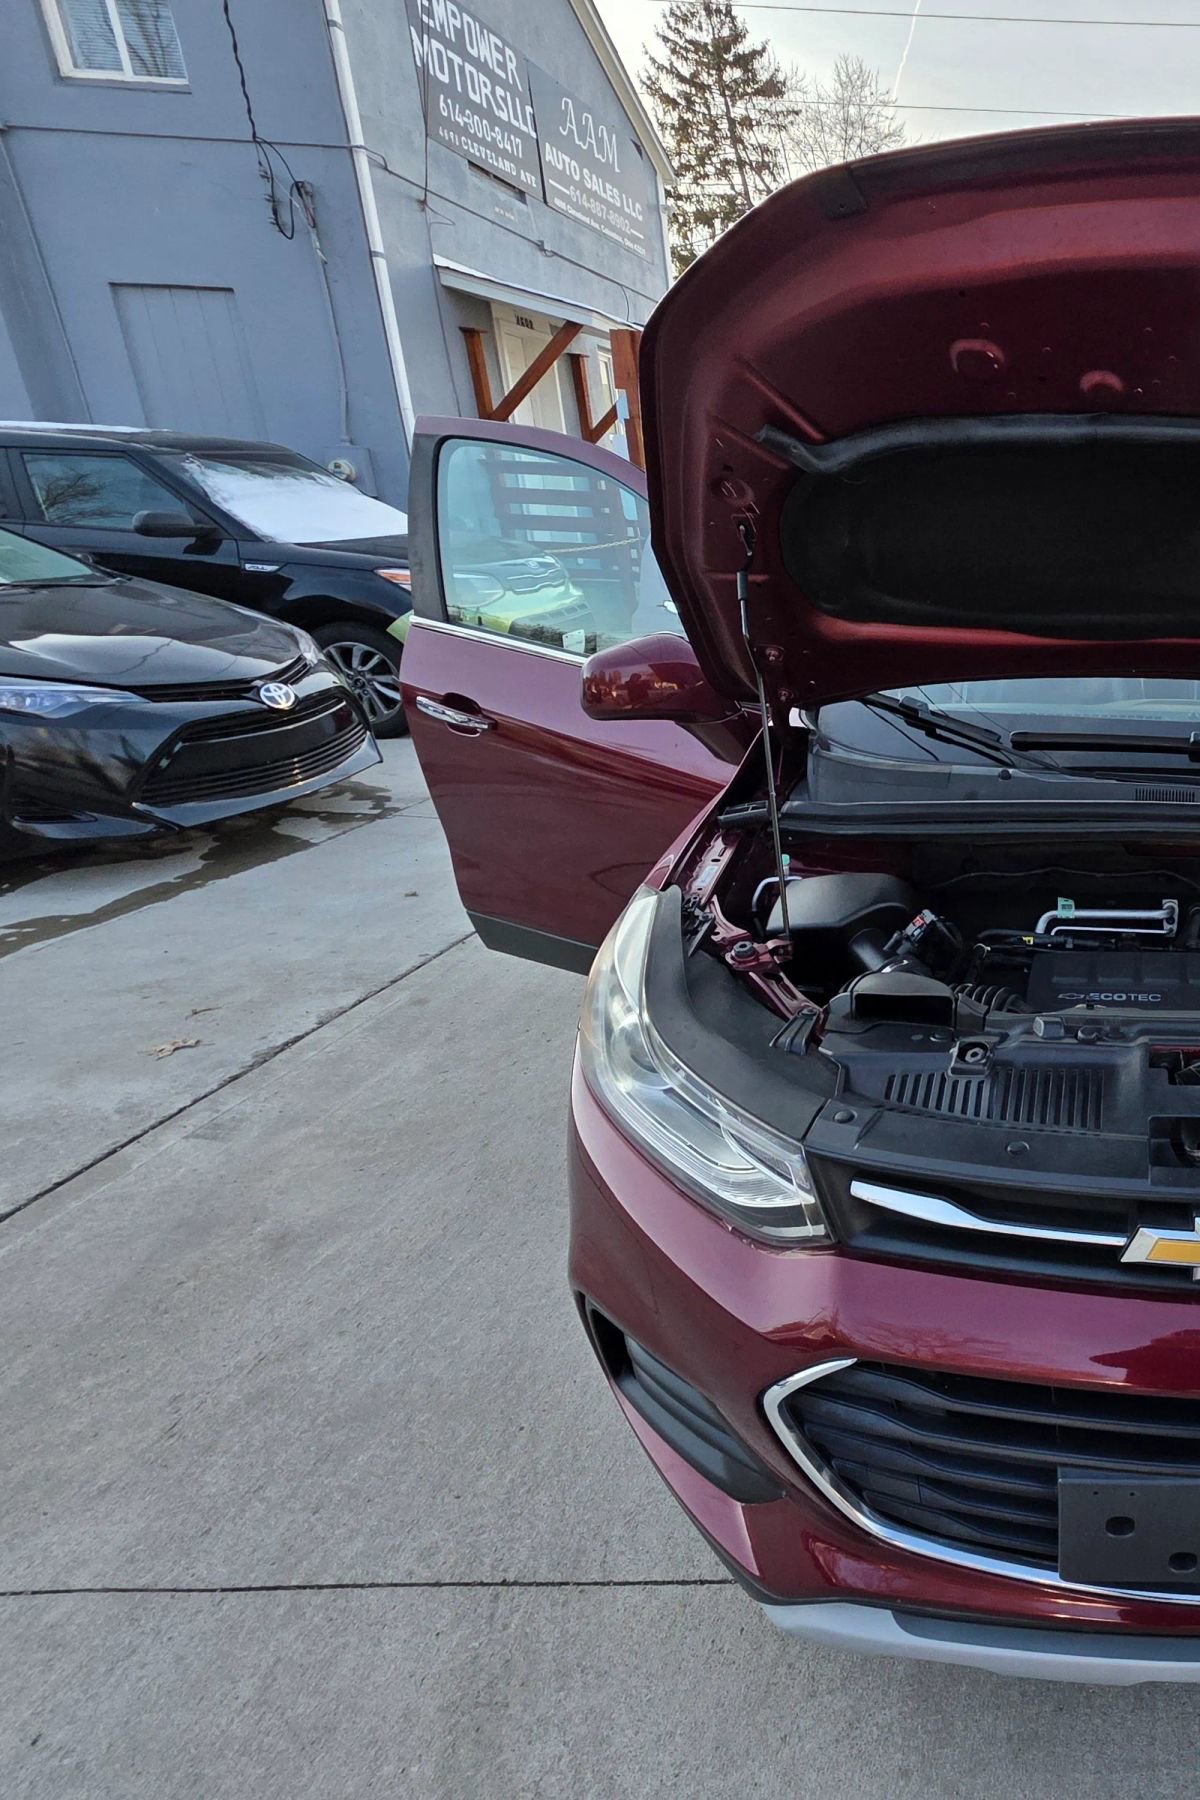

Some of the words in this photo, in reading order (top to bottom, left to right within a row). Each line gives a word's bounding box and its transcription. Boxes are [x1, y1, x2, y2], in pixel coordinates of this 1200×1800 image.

[440, 94, 522, 158] 614-300-8417
[559, 97, 621, 173] AAM
[461, 136, 517, 175] CLEVELAND
[520, 169, 537, 188] AVE
[545, 142, 580, 181] AUTO
[582, 168, 621, 207] SALES
[622, 193, 643, 222] LLC
[1087, 992, 1162, 1002] ECOTEC
